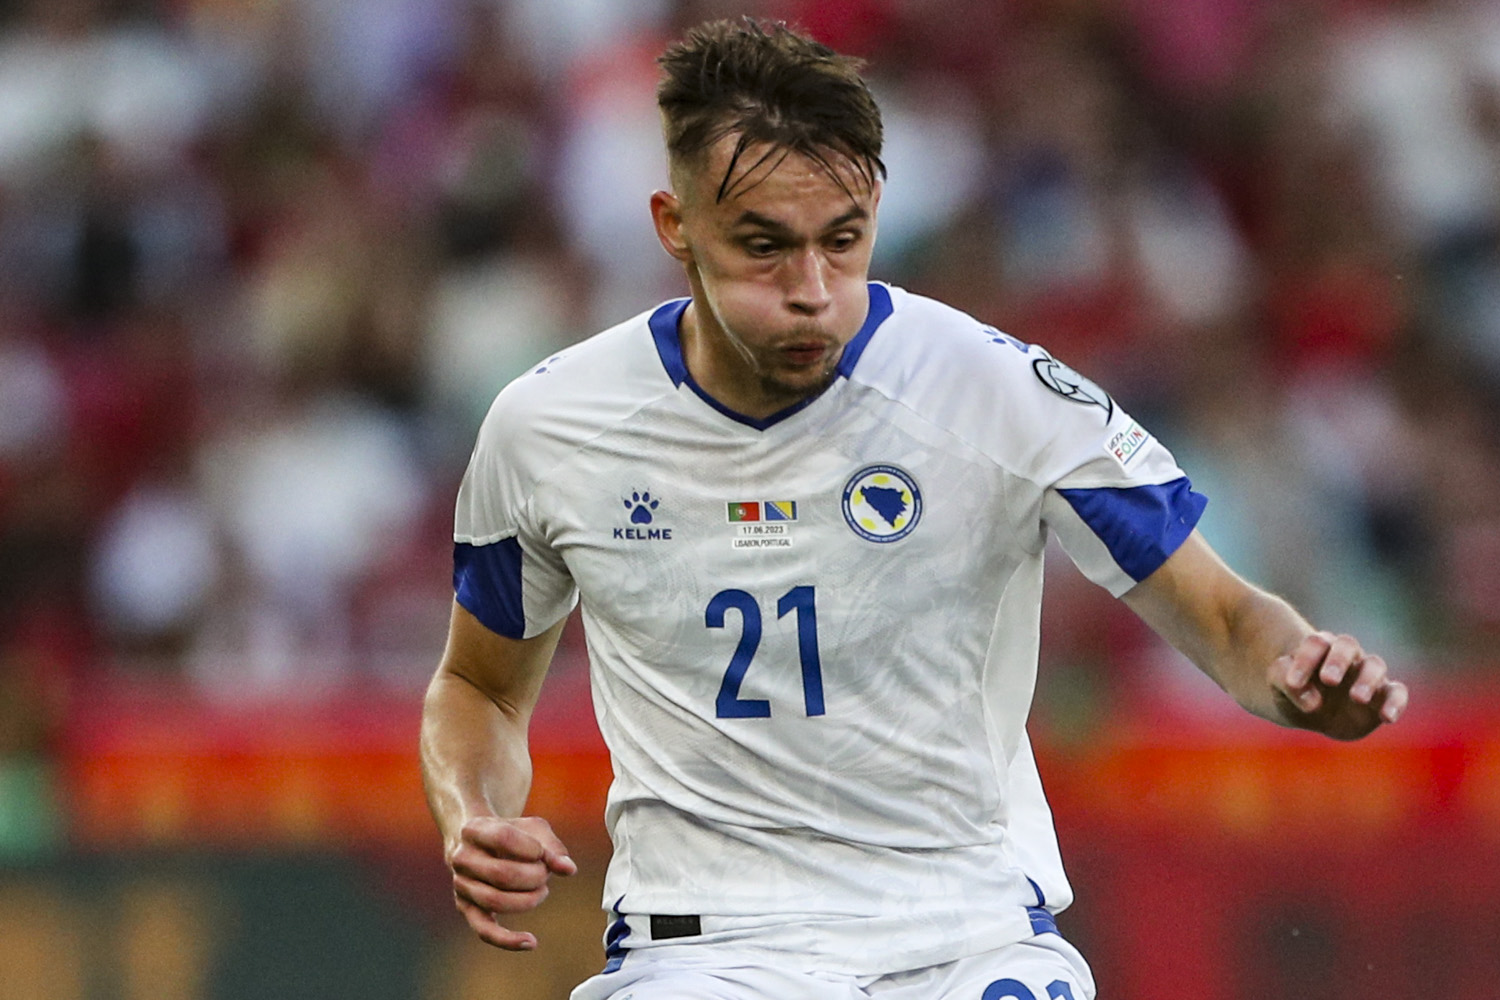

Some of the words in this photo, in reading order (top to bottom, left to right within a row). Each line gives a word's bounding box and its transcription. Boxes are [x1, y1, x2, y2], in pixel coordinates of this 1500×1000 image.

[1114, 428, 1144, 462] FOUN
[613, 528, 672, 540] KELME
[743, 525, 784, 535] 17.06.2023
[705, 586, 826, 719] 21
